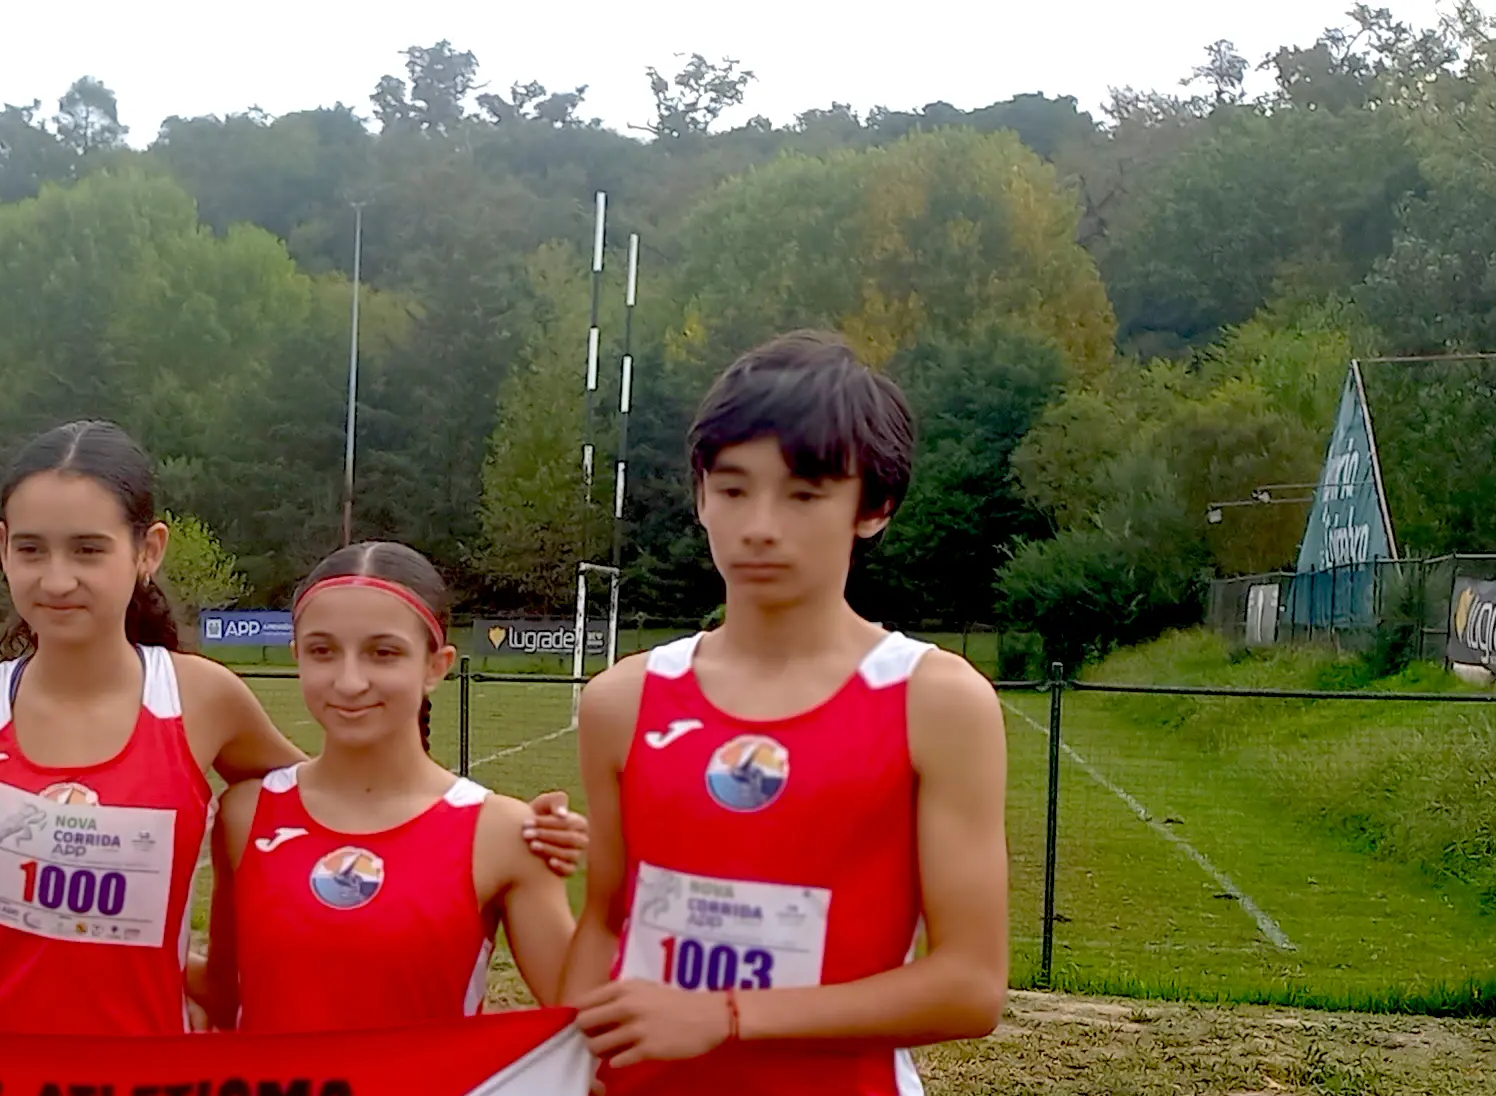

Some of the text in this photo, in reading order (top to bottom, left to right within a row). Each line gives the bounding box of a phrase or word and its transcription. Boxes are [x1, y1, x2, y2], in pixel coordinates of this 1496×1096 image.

[225, 620, 262, 637] APP
[508, 626, 576, 653] lugrade
[55, 814, 98, 831] NOVA
[53, 829, 121, 848] CORRIDA
[51, 842, 87, 857] APP
[19, 859, 127, 916] 1000
[689, 880, 735, 898] NOVA
[687, 897, 764, 920] CORRIDA
[660, 935, 774, 992] 1003
